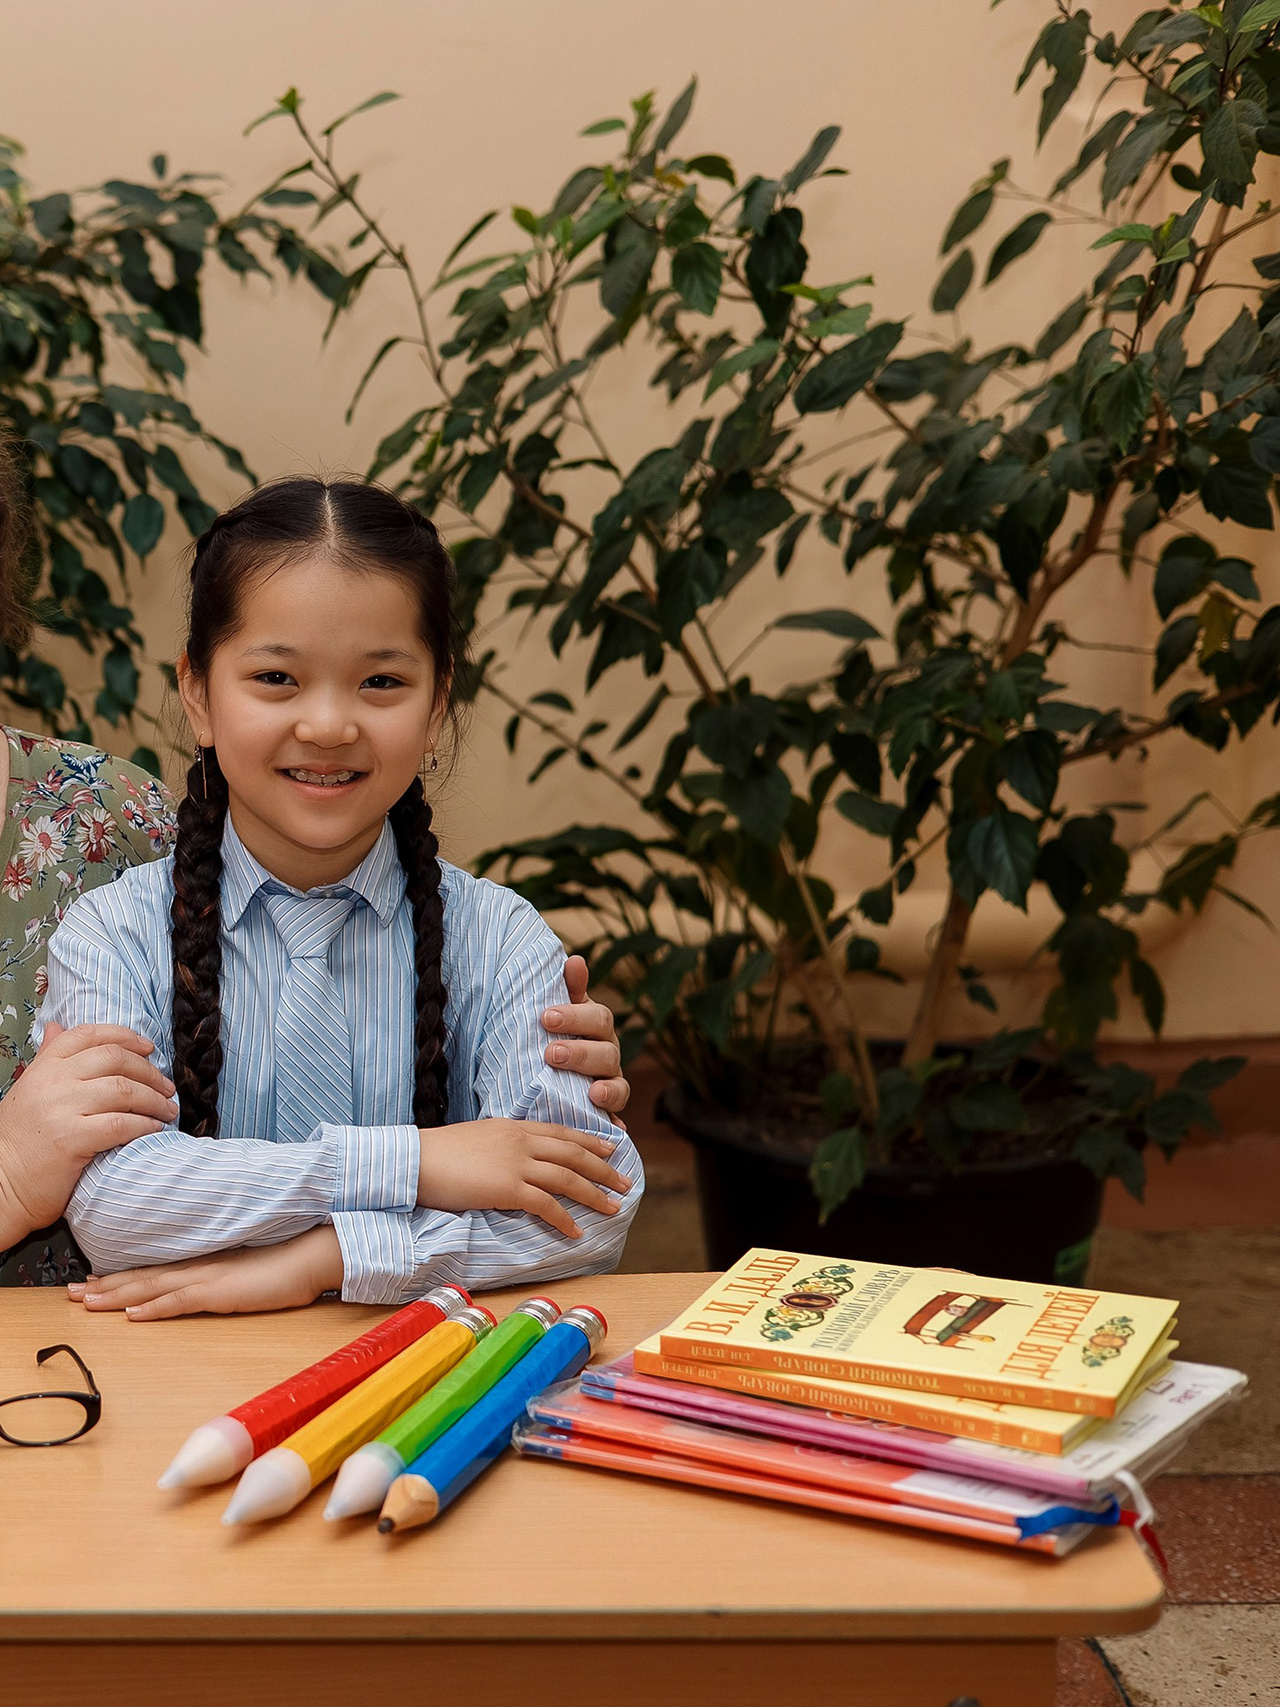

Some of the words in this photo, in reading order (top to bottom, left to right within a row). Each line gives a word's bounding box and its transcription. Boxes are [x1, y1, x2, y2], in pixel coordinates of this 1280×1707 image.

[722, 1255, 801, 1299] ДАЛЬ
[810, 1302, 870, 1349] ТОЛКОВЫЙ
[853, 1269, 901, 1303] СЛОВАРЬ
[1026, 1290, 1101, 1346] ДЕТЕЙ
[691, 1345, 727, 1360] ДЕТЕЙ
[730, 1351, 755, 1363] ДЛЯ
[999, 1341, 1063, 1382] ДЛЯ
[661, 1361, 697, 1376] ДЕТЕЙ
[697, 1369, 721, 1380] ДЛЯ
[772, 1354, 846, 1377] СЛОВАРЬ
[848, 1365, 941, 1390] ТОЛКОВЫЙ
[737, 1373, 806, 1397] СЛОВАРЬ
[807, 1388, 894, 1416] ТОЛКОВЫЙ
